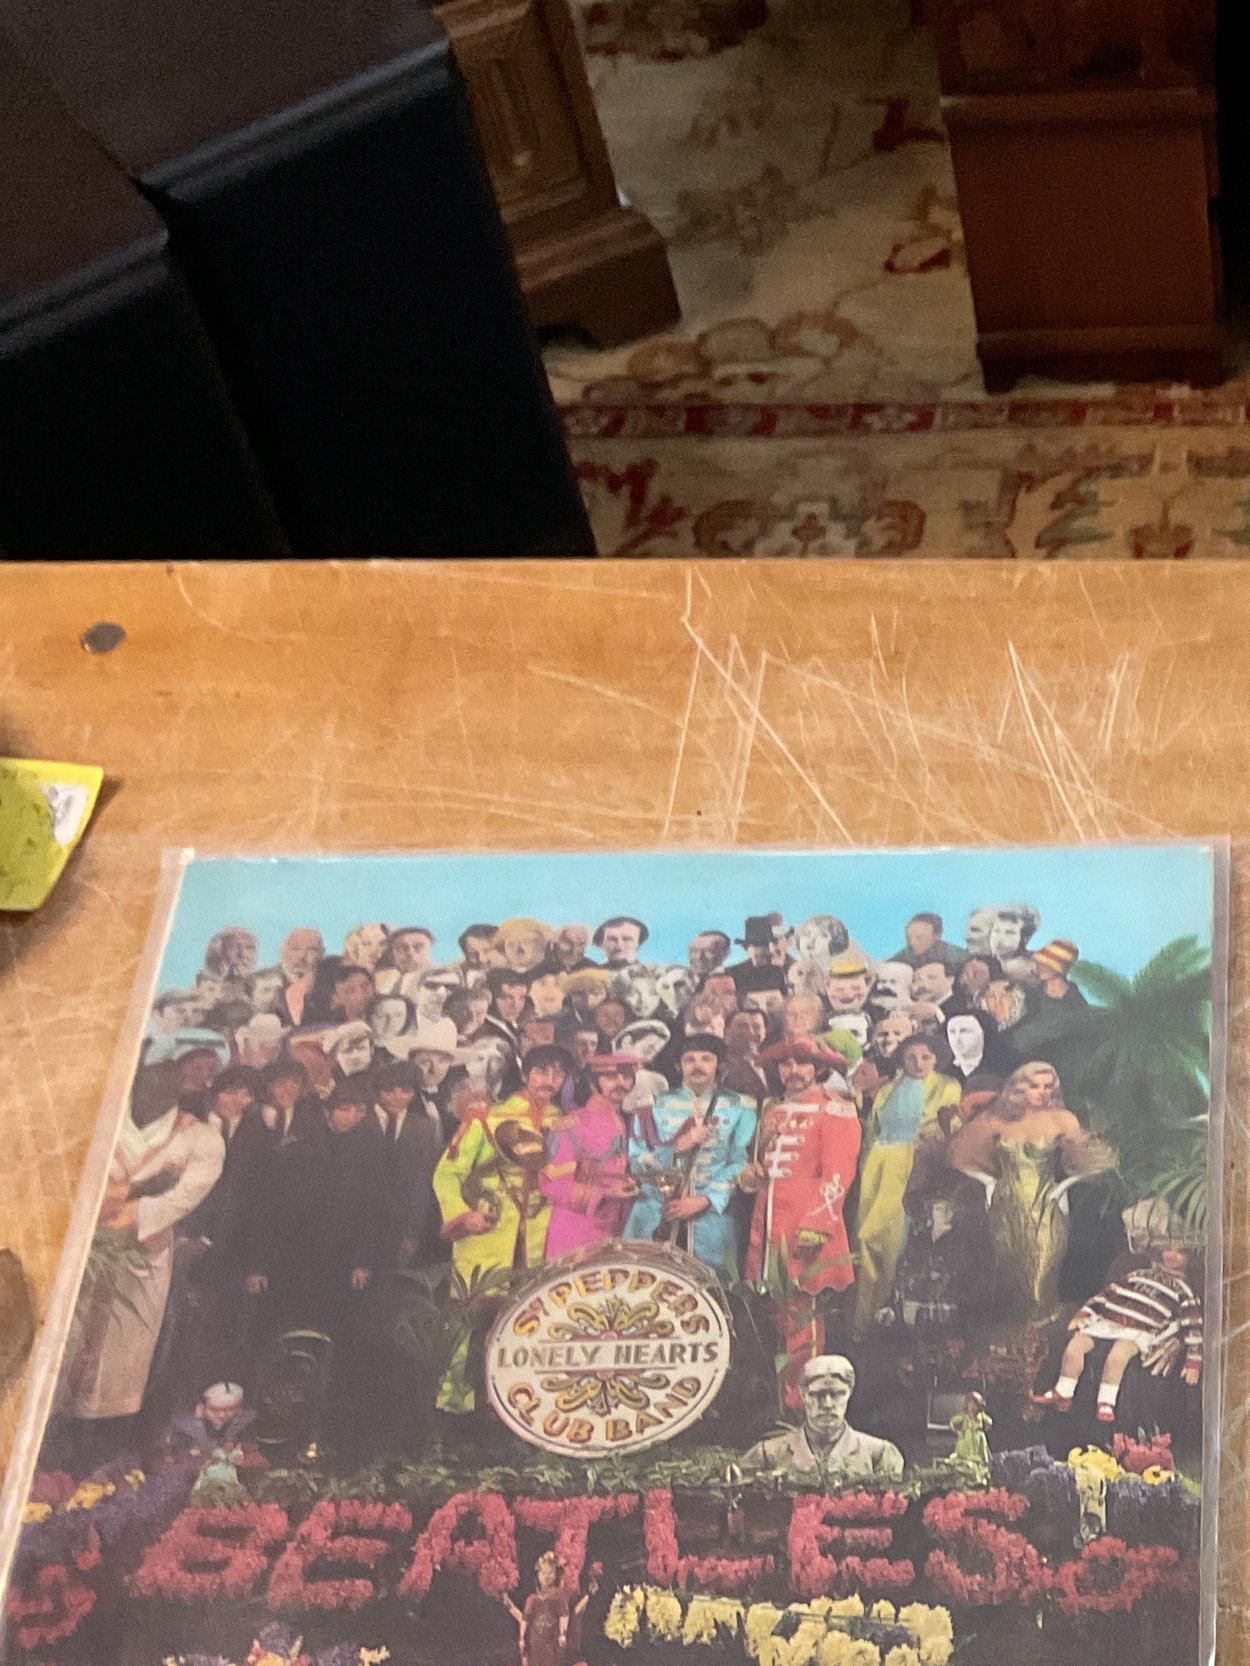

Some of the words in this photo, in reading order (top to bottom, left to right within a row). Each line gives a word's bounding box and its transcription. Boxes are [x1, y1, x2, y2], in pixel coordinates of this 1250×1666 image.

[548, 1268, 710, 1335] PEPPERS
[498, 1344, 598, 1368] LONELY
[614, 1341, 719, 1364] HEARTS
[507, 1382, 594, 1443] CLUB
[605, 1376, 701, 1441] BAND
[130, 1486, 1056, 1609] BEATLES
